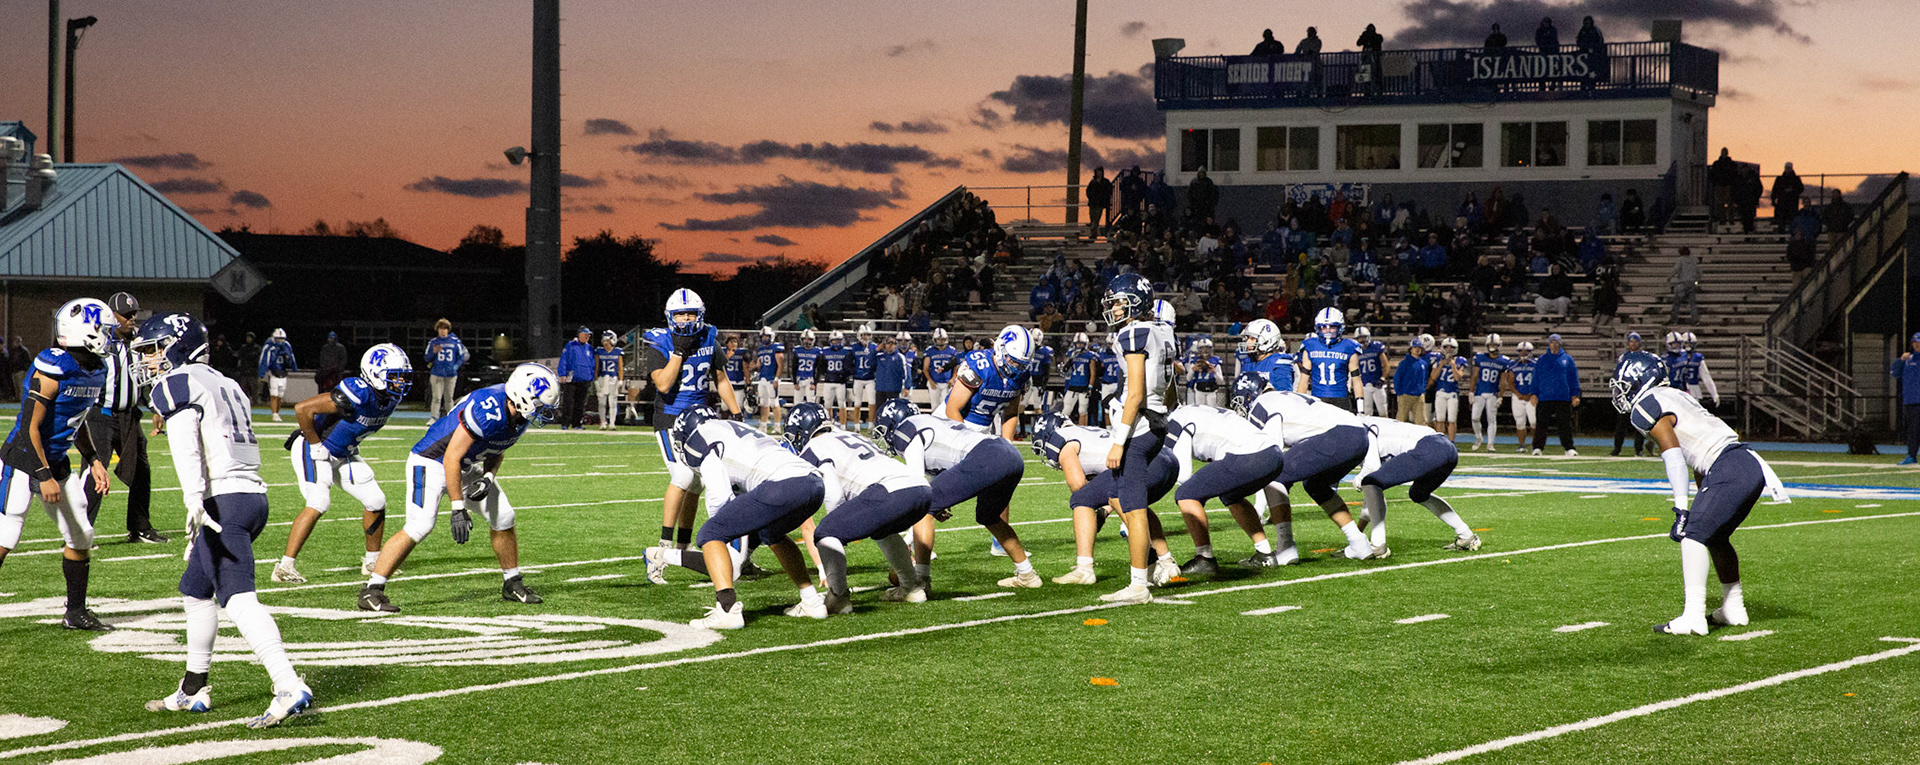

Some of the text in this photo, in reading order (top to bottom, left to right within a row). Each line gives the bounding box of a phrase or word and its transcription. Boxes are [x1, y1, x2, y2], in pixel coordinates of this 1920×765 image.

[1228, 62, 1312, 84] SENIOR NIGHT
[1472, 53, 1588, 80] ISLANDERS
[83, 306, 102, 324] M
[437, 349, 453, 362] 63
[969, 351, 990, 371] 56
[1310, 350, 1348, 361] MIDDLETOWN
[602, 360, 615, 372] 12
[726, 360, 740, 372] 51
[798, 358, 815, 372] 29
[827, 360, 843, 372] 80
[1318, 361, 1337, 385] 11
[1360, 358, 1377, 374] 76
[679, 361, 711, 392] 22
[1481, 368, 1499, 383] 88
[1515, 372, 1533, 386] 44
[220, 386, 258, 445] 11
[480, 395, 502, 422] 57
[67, 406, 91, 441] 4
